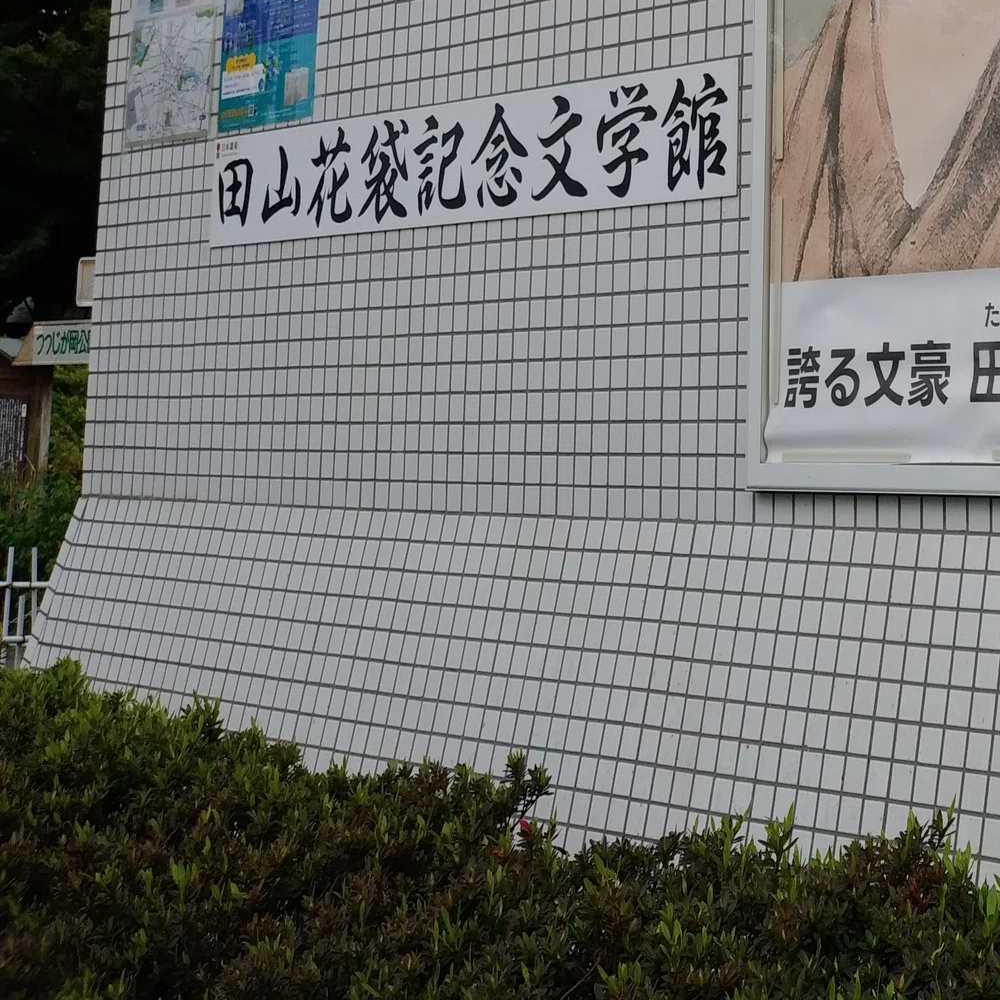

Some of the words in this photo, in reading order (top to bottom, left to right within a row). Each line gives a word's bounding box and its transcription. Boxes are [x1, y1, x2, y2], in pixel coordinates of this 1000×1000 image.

[219, 72, 728, 228] 田山花袋記念文学館
[984, 302, 1000, 328] た
[783, 340, 952, 409] 誇る文豪
